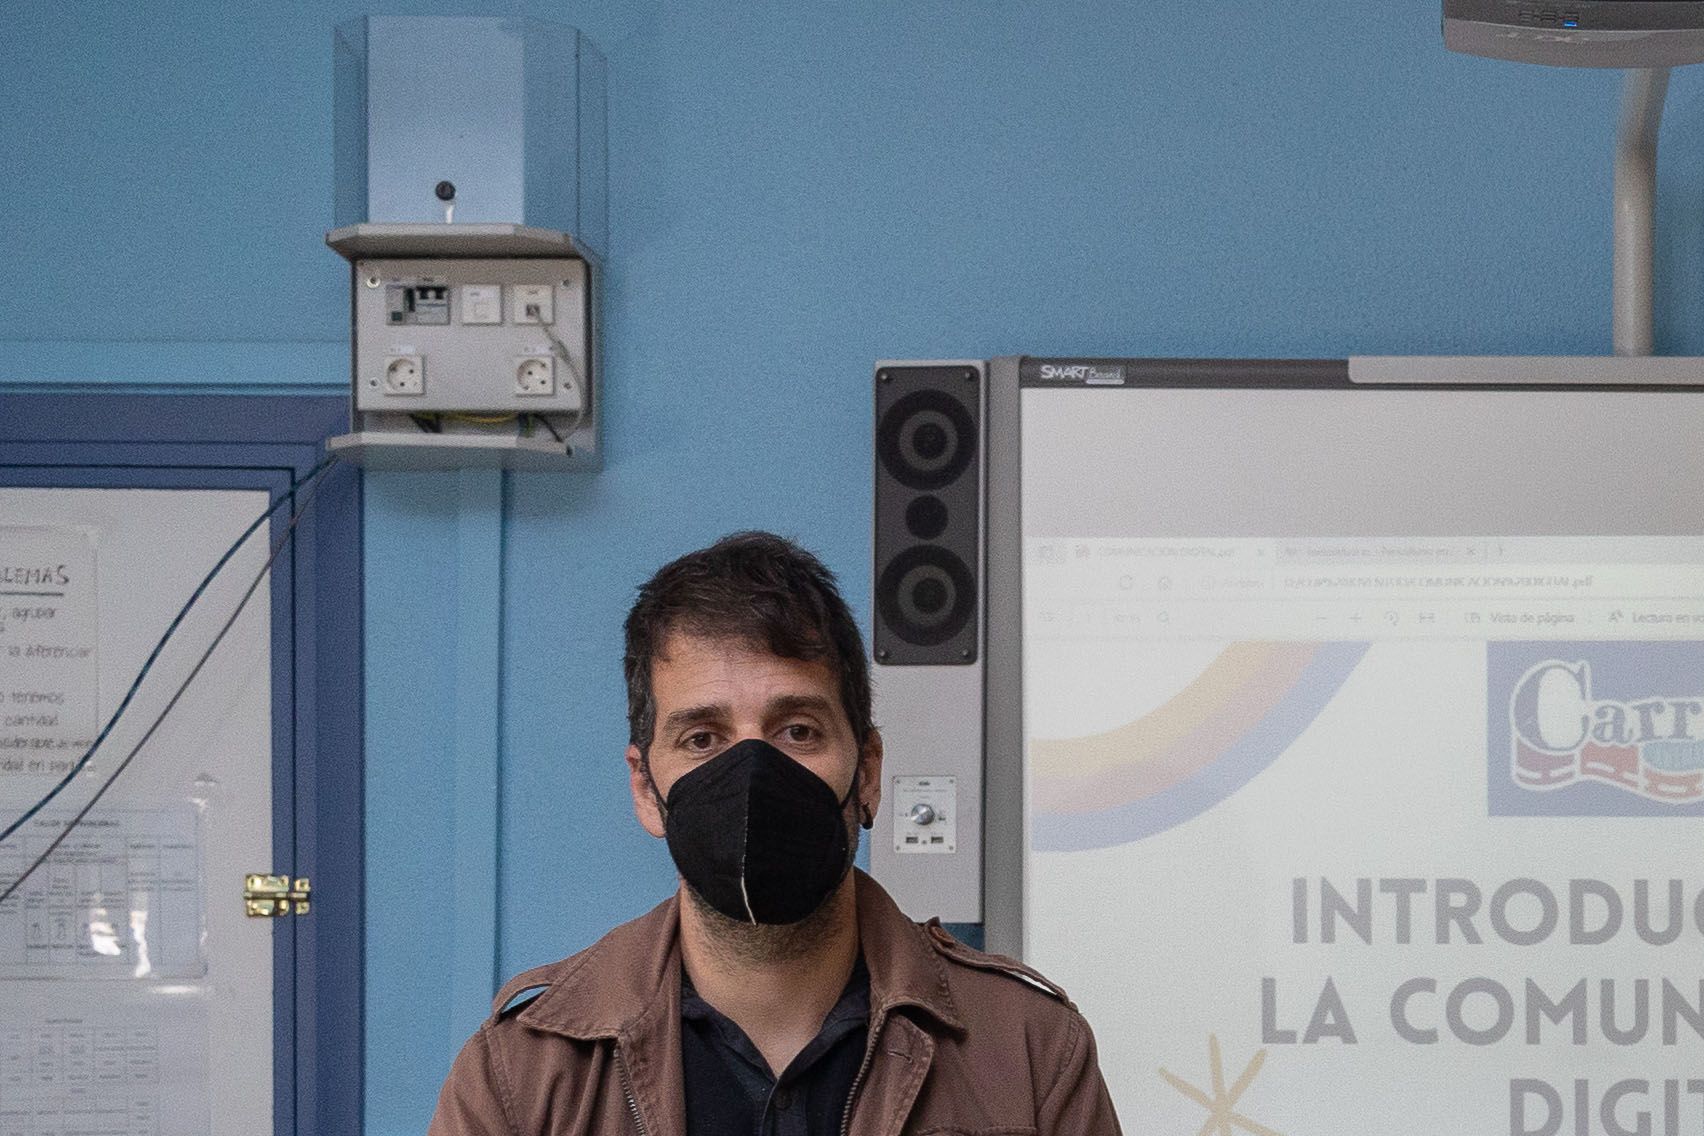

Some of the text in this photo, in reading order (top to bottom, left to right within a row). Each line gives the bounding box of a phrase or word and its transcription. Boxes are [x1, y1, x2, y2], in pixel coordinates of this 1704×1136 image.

[1041, 364, 1089, 379] SMART
[0, 564, 70, 585] LEMAS
[1489, 611, 1576, 626] Vista de página
[1632, 611, 1673, 623] Lectura
[1675, 613, 1690, 623] en
[1261, 976, 1358, 1046] LA
